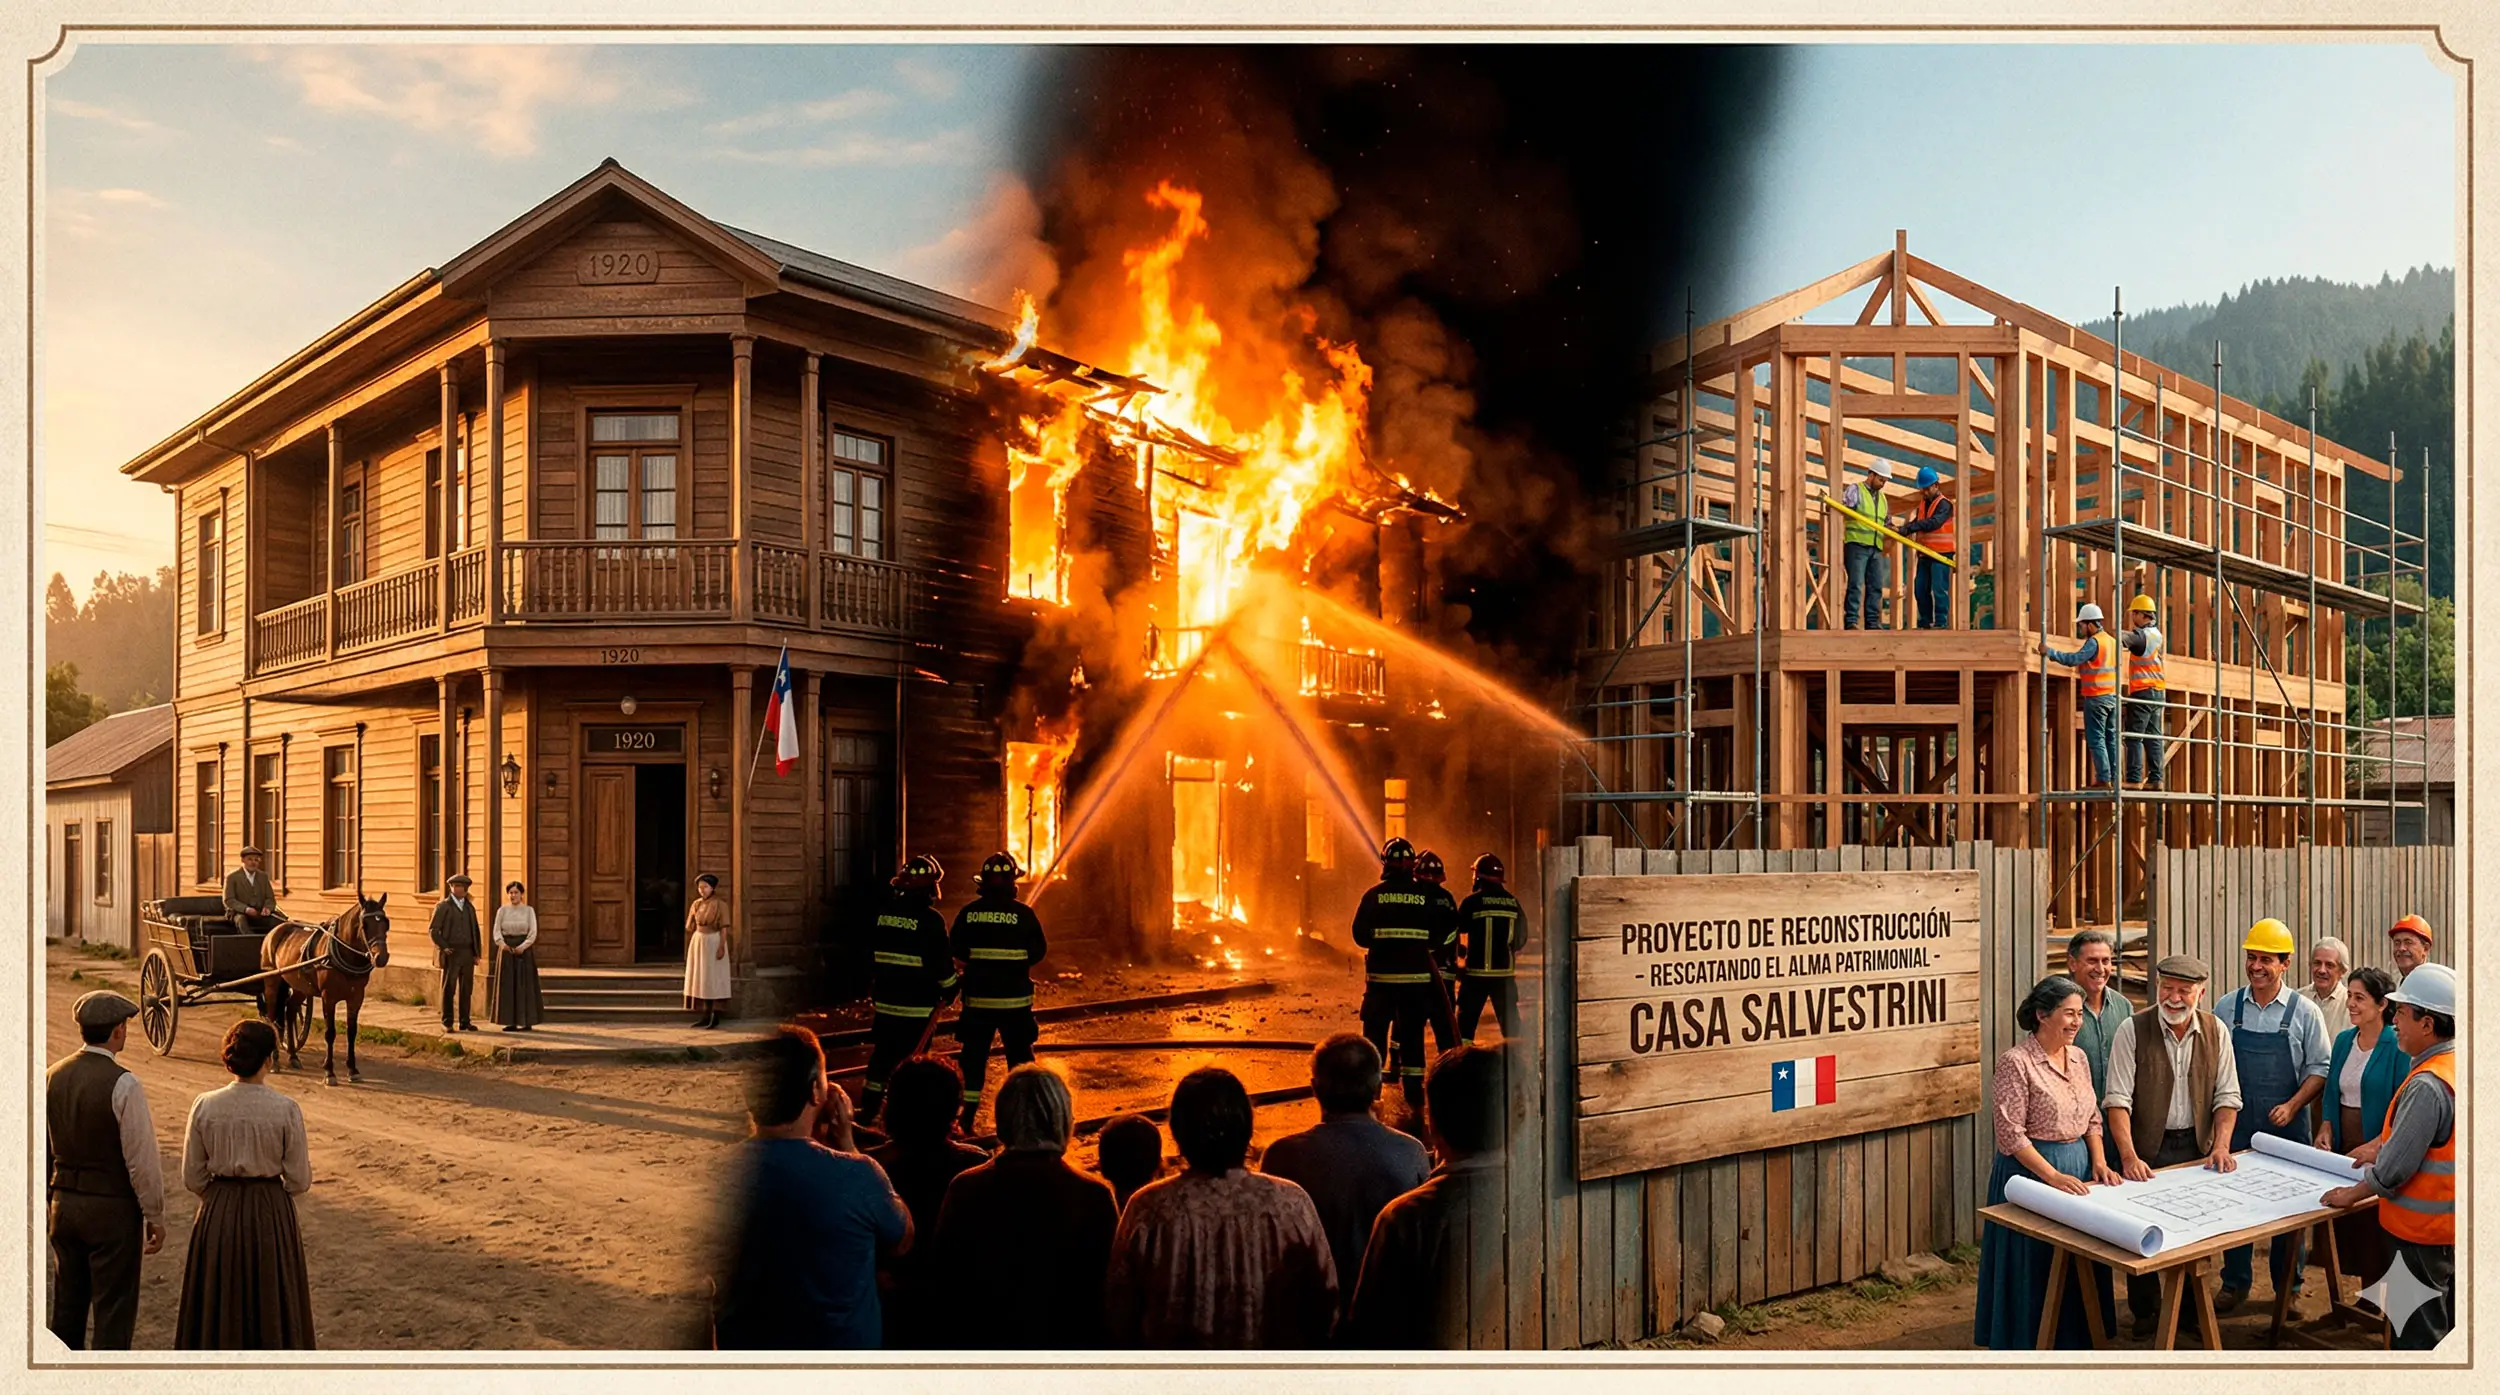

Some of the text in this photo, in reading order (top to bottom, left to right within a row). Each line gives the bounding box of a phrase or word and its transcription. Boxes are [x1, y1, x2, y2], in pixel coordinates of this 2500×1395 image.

[589, 253, 650, 277] 1920
[601, 648, 640, 664] 1920
[613, 732, 655, 749] 1920
[1621, 906, 1951, 955] PROYECTO DE RECONSTRUCCIÓN
[1650, 957, 1761, 987] RESCATANDO
[1766, 956, 1785, 978] EL
[1788, 953, 1832, 977] ALMA
[1836, 947, 1931, 973] PATRIMONIAL
[1630, 978, 1947, 1054] CASA SALVESTRINI
